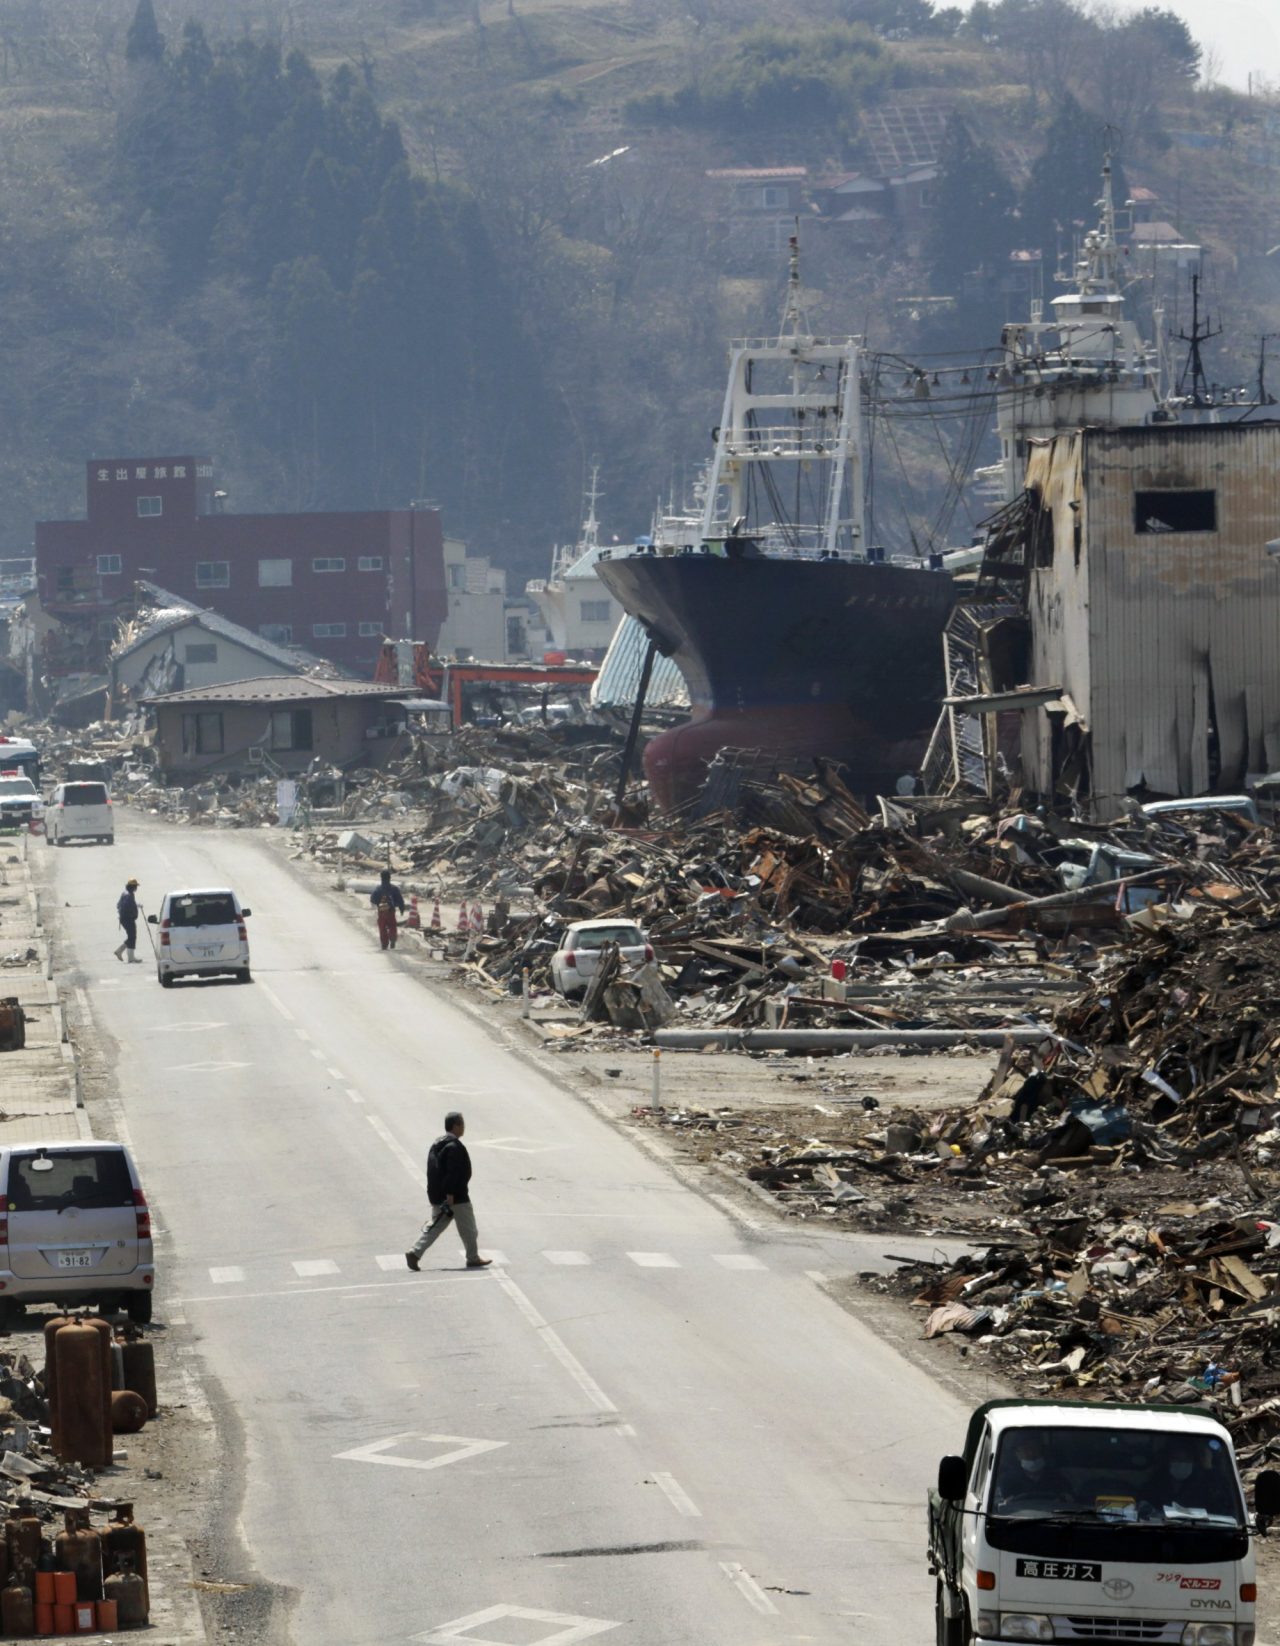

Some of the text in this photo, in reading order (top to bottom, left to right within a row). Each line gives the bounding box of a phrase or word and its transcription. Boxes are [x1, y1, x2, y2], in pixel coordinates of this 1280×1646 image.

[1023, 1561, 1096, 1580] 高圧ガス
[1190, 1599, 1232, 1609] DYNA
